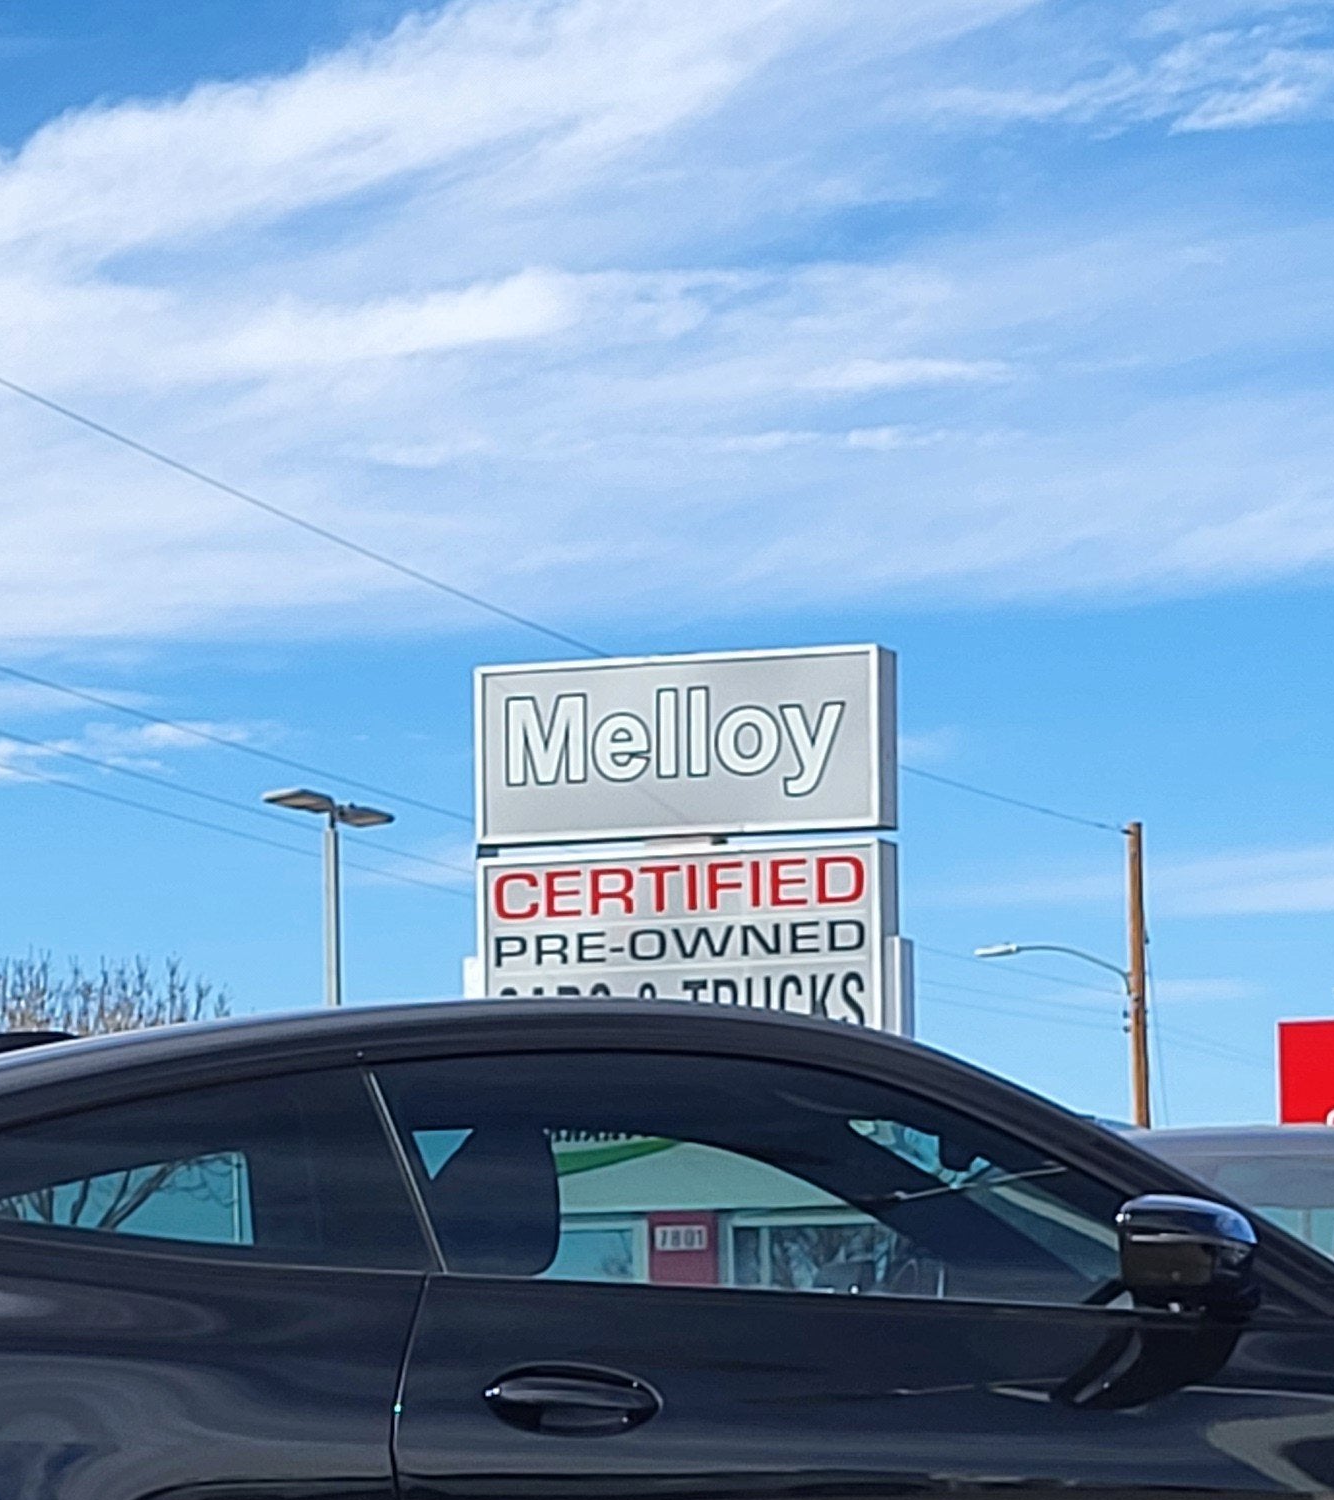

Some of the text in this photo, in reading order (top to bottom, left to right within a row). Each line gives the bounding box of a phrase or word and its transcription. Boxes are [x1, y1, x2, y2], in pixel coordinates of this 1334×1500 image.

[504, 686, 846, 798] Melloy
[492, 855, 866, 921] CERTIFIED
[493, 919, 866, 968] PRE-OWNED
